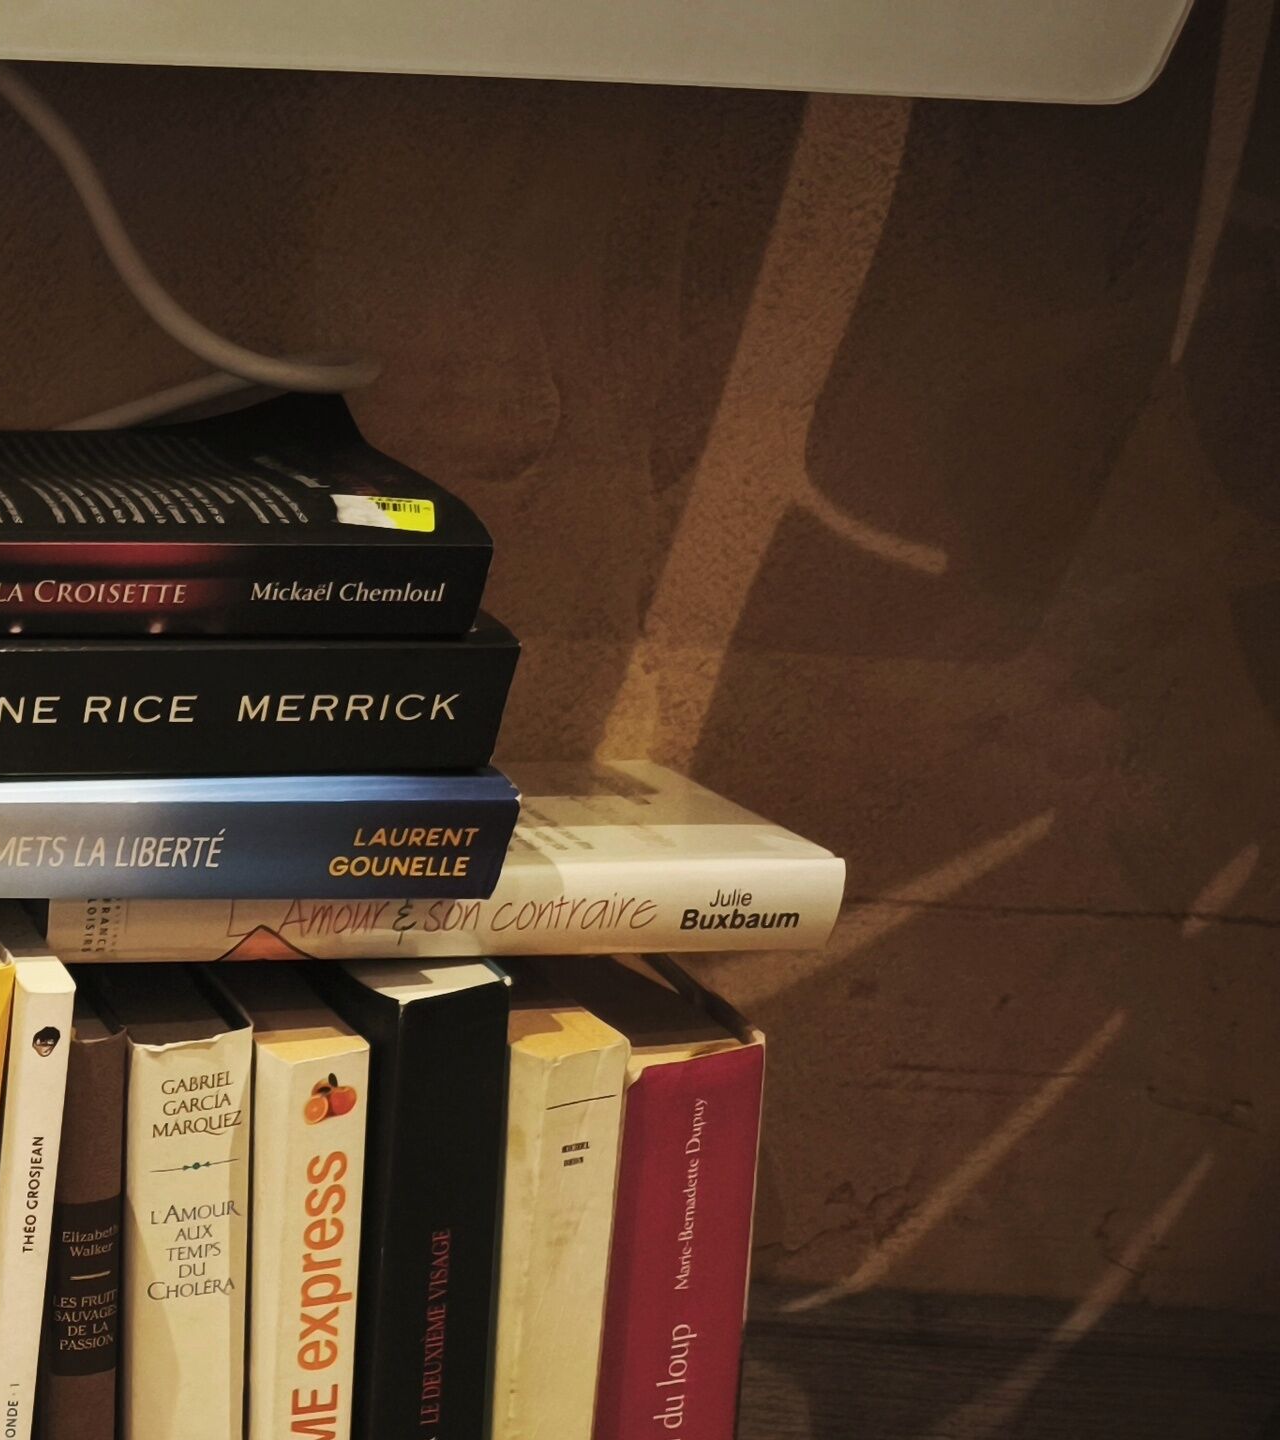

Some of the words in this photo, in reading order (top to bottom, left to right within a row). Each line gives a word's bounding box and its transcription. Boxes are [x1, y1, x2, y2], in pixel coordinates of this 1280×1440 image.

[34, 579, 187, 605] CROISETTE
[250, 581, 331, 602] Mickaël
[339, 581, 445, 603] Chemloul
[82, 695, 199, 724] RICE
[236, 692, 462, 724] MERRICK
[73, 836, 107, 868] LA
[113, 828, 227, 868] LIBERTÉ
[352, 826, 480, 847] LAURENT
[328, 855, 469, 878] GOUNELLE
[708, 888, 753, 909] Julie
[278, 898, 391, 938] Amour
[392, 898, 418, 946] &
[424, 896, 481, 933] son
[490, 896, 659, 933] contraire
[679, 908, 801, 932] Buxbaum
[161, 1070, 234, 1095] GABRIEL
[162, 1089, 232, 1116] GARCÍA
[152, 1110, 242, 1138] MÁRQUEZ
[685, 1098, 708, 1155] Dupuy
[26, 1136, 45, 1210] GROSJEAN
[150, 1200, 242, 1225] L'AMOUR
[674, 1156, 700, 1291] Marie-Bernadette
[23, 1215, 38, 1253] THÉO
[174, 1224, 214, 1242] AUX
[70, 1242, 115, 1258] Walker
[166, 1242, 222, 1262] TEMPS
[297, 1150, 353, 1372] express
[178, 1262, 206, 1279] DU
[429, 1229, 451, 1303] VISAGE
[68, 1325, 87, 1336] DE
[93, 1321, 109, 1335] LA
[59, 1333, 115, 1351] PASSION
[421, 1303, 446, 1398] DEUXIÈME
[656, 1323, 697, 1388] loup
[420, 1403, 439, 1426] LE
[653, 1394, 685, 1429] du
